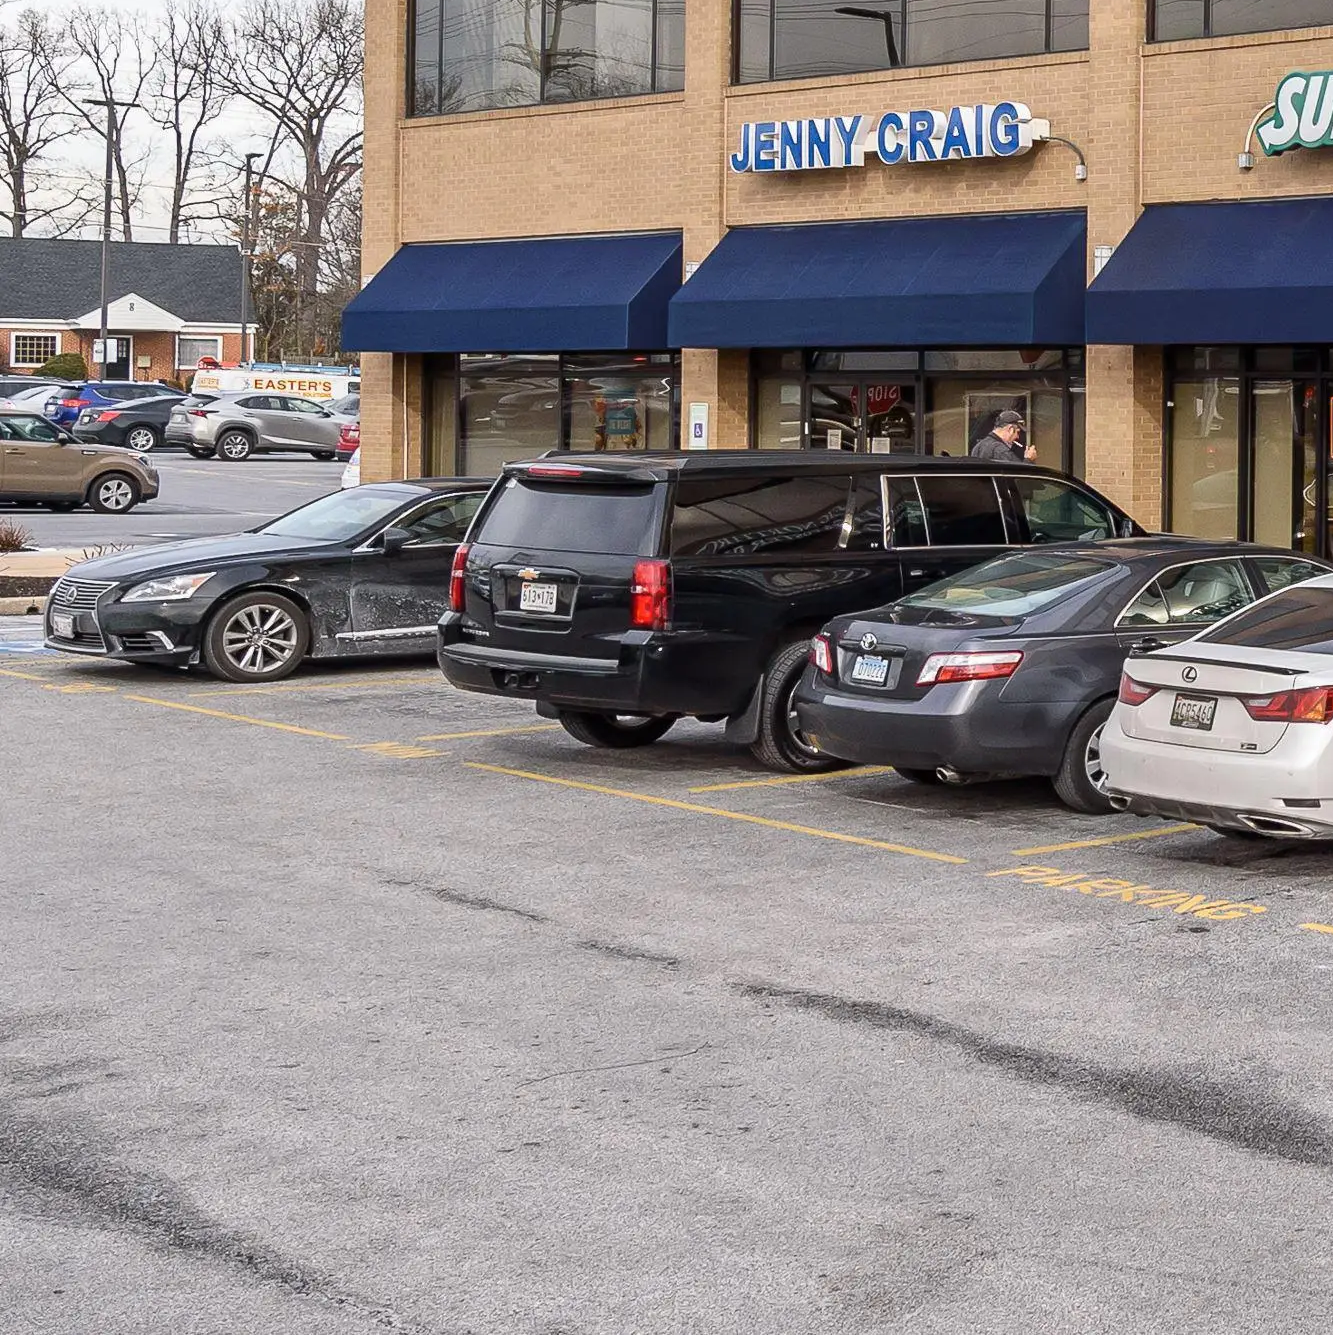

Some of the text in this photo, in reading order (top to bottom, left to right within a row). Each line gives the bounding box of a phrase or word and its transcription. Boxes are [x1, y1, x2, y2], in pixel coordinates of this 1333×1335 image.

[730, 101, 1028, 173] JENNY CRAIG
[254, 379, 332, 391] EASTER'S
[986, 865, 1268, 920] PARKING
